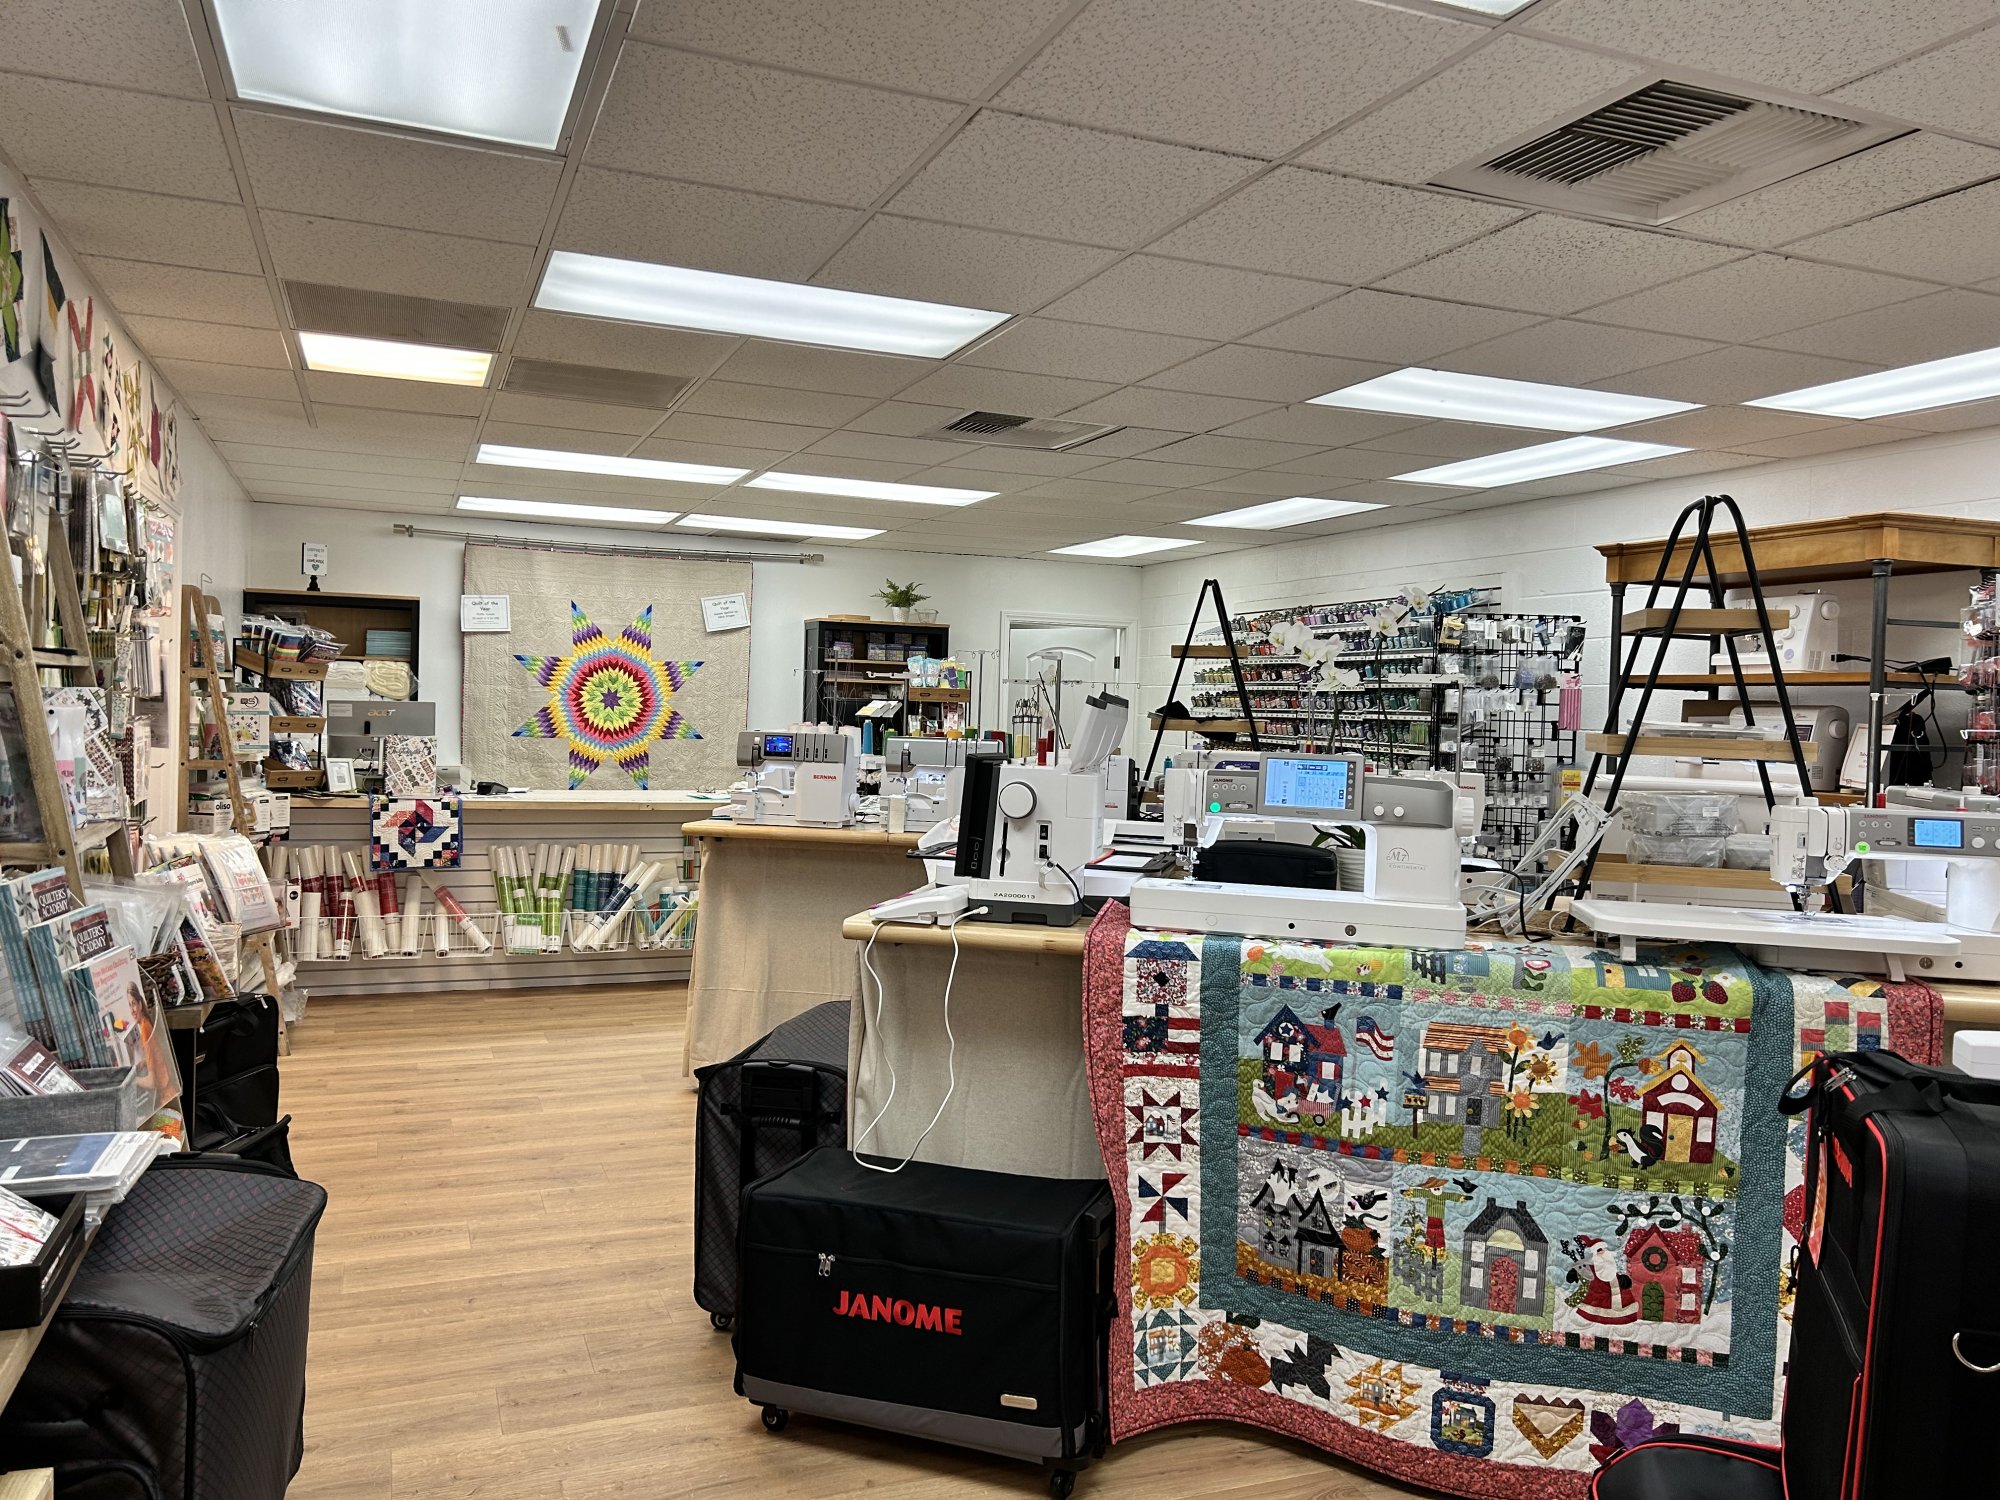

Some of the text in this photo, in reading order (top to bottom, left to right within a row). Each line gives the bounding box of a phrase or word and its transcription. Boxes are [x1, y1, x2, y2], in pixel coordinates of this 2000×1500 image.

[367, 708, 396, 717] acer
[216, 802, 231, 810] oliso
[42, 900, 69, 918] ACADEMY
[77, 925, 105, 945] QUILTER'S
[80, 936, 107, 955] ACADEMY
[832, 1290, 963, 1335] JANOME
